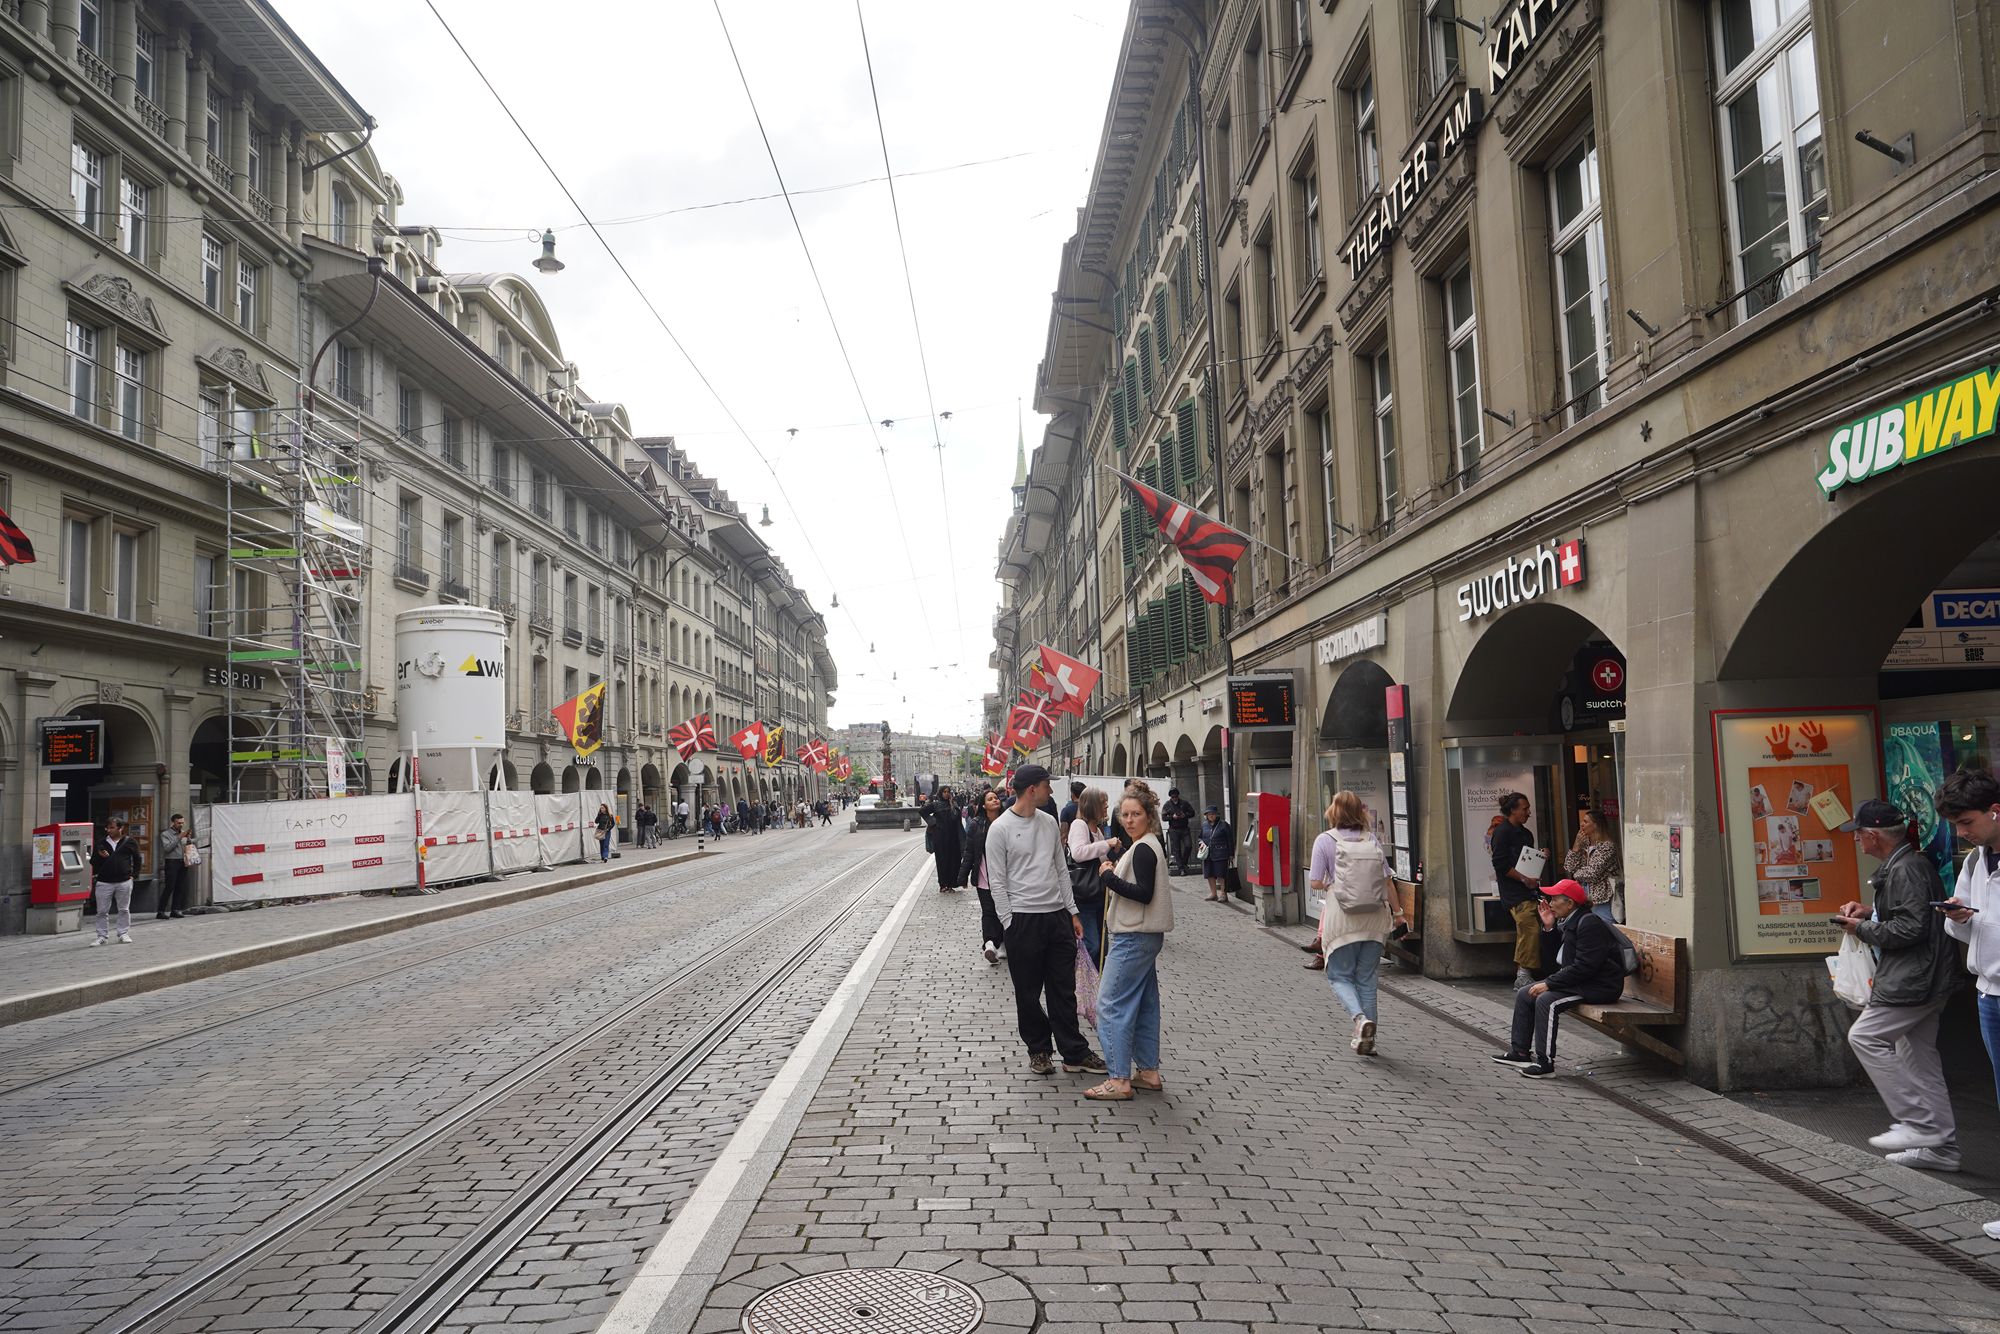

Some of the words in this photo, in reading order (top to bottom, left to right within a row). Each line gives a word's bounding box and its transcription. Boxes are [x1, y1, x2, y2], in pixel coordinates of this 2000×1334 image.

[1347, 141, 1428, 281] THEATER
[1443, 88, 1473, 158] AM
[1818, 370, 2000, 492] SUBWAY
[1457, 544, 1557, 622] swatch
[1318, 620, 1369, 666] DECATHLON
[209, 668, 266, 690] ESPRIT
[1586, 700, 1622, 709] swatch
[575, 754, 597, 766] GLOBUS
[1467, 787, 1498, 796] Rockrose
[1467, 796, 1489, 805] Hydro
[62, 829, 80, 837] Tickets
[296, 840, 325, 848] HERZOG
[355, 835, 384, 844] HERZOG
[294, 866, 323, 875] HERZOG
[353, 858, 382, 867] HERZOG
